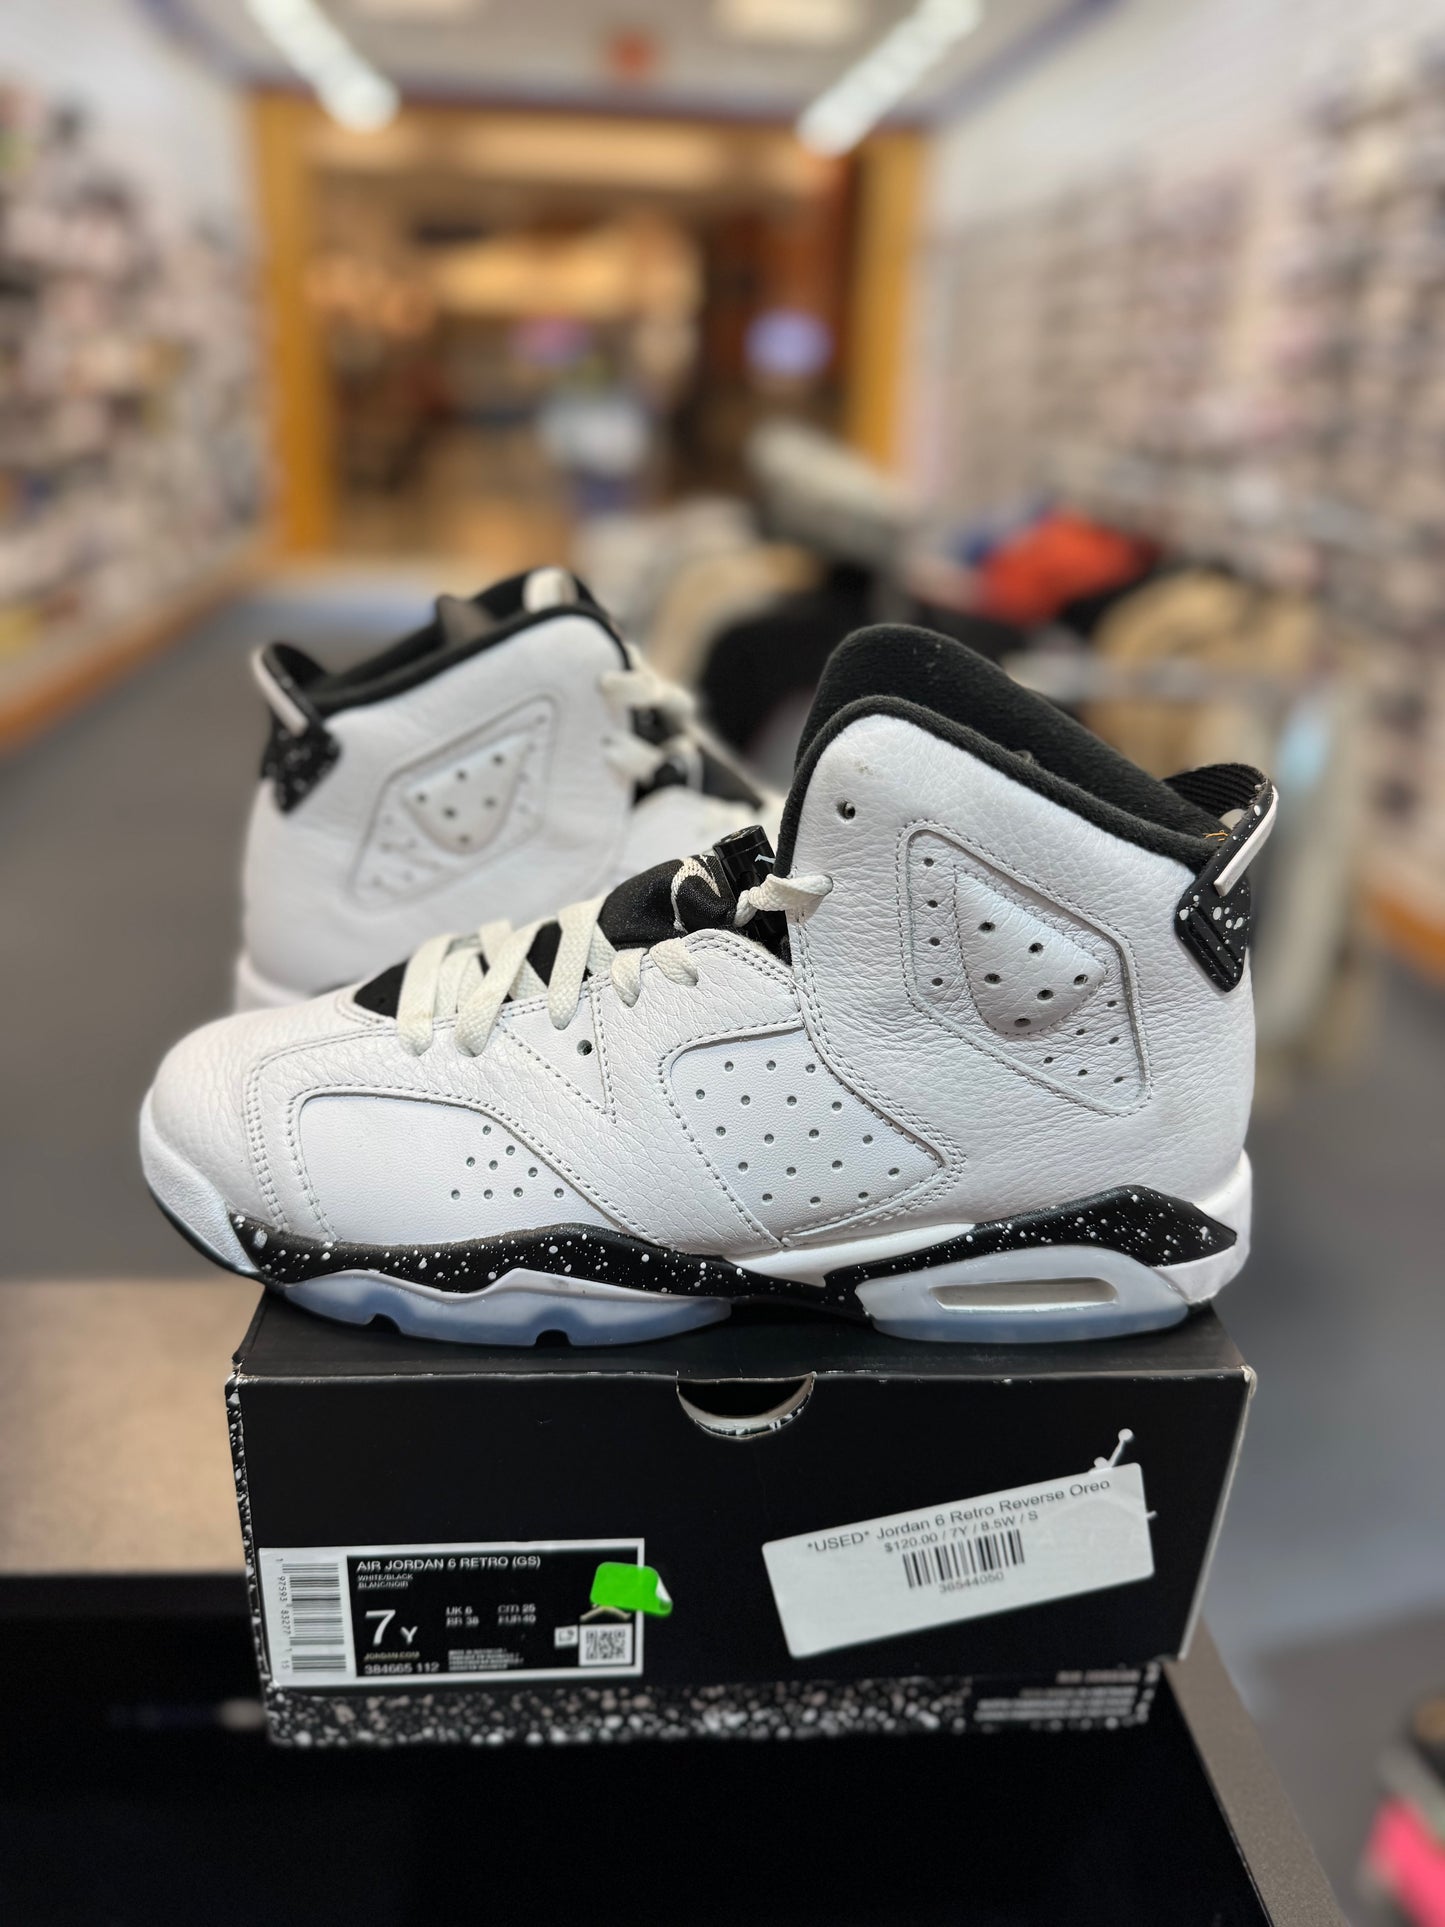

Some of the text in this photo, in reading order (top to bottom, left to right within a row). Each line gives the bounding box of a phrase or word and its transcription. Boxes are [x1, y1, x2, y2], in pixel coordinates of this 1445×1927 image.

[876, 1520, 930, 1540] Jordan
[934, 1514, 945, 1526] 6
[950, 1505, 994, 1524] Retro
[1000, 1490, 1065, 1512] Reverse
[1070, 1480, 1110, 1497] Oreo
[884, 1532, 938, 1553] $120.00
[952, 1524, 969, 1538] 7Y
[981, 1514, 1016, 1532] 8.5W
[1028, 1510, 1038, 1522] S
[357, 1555, 541, 1572] AIR JORDAN 6 RETRO (GS)
[357, 1573, 414, 1582] WHITE/BLACK
[446, 1606, 462, 1616] UK
[364, 1663, 413, 1675] 384665
[416, 1661, 440, 1673] 112
